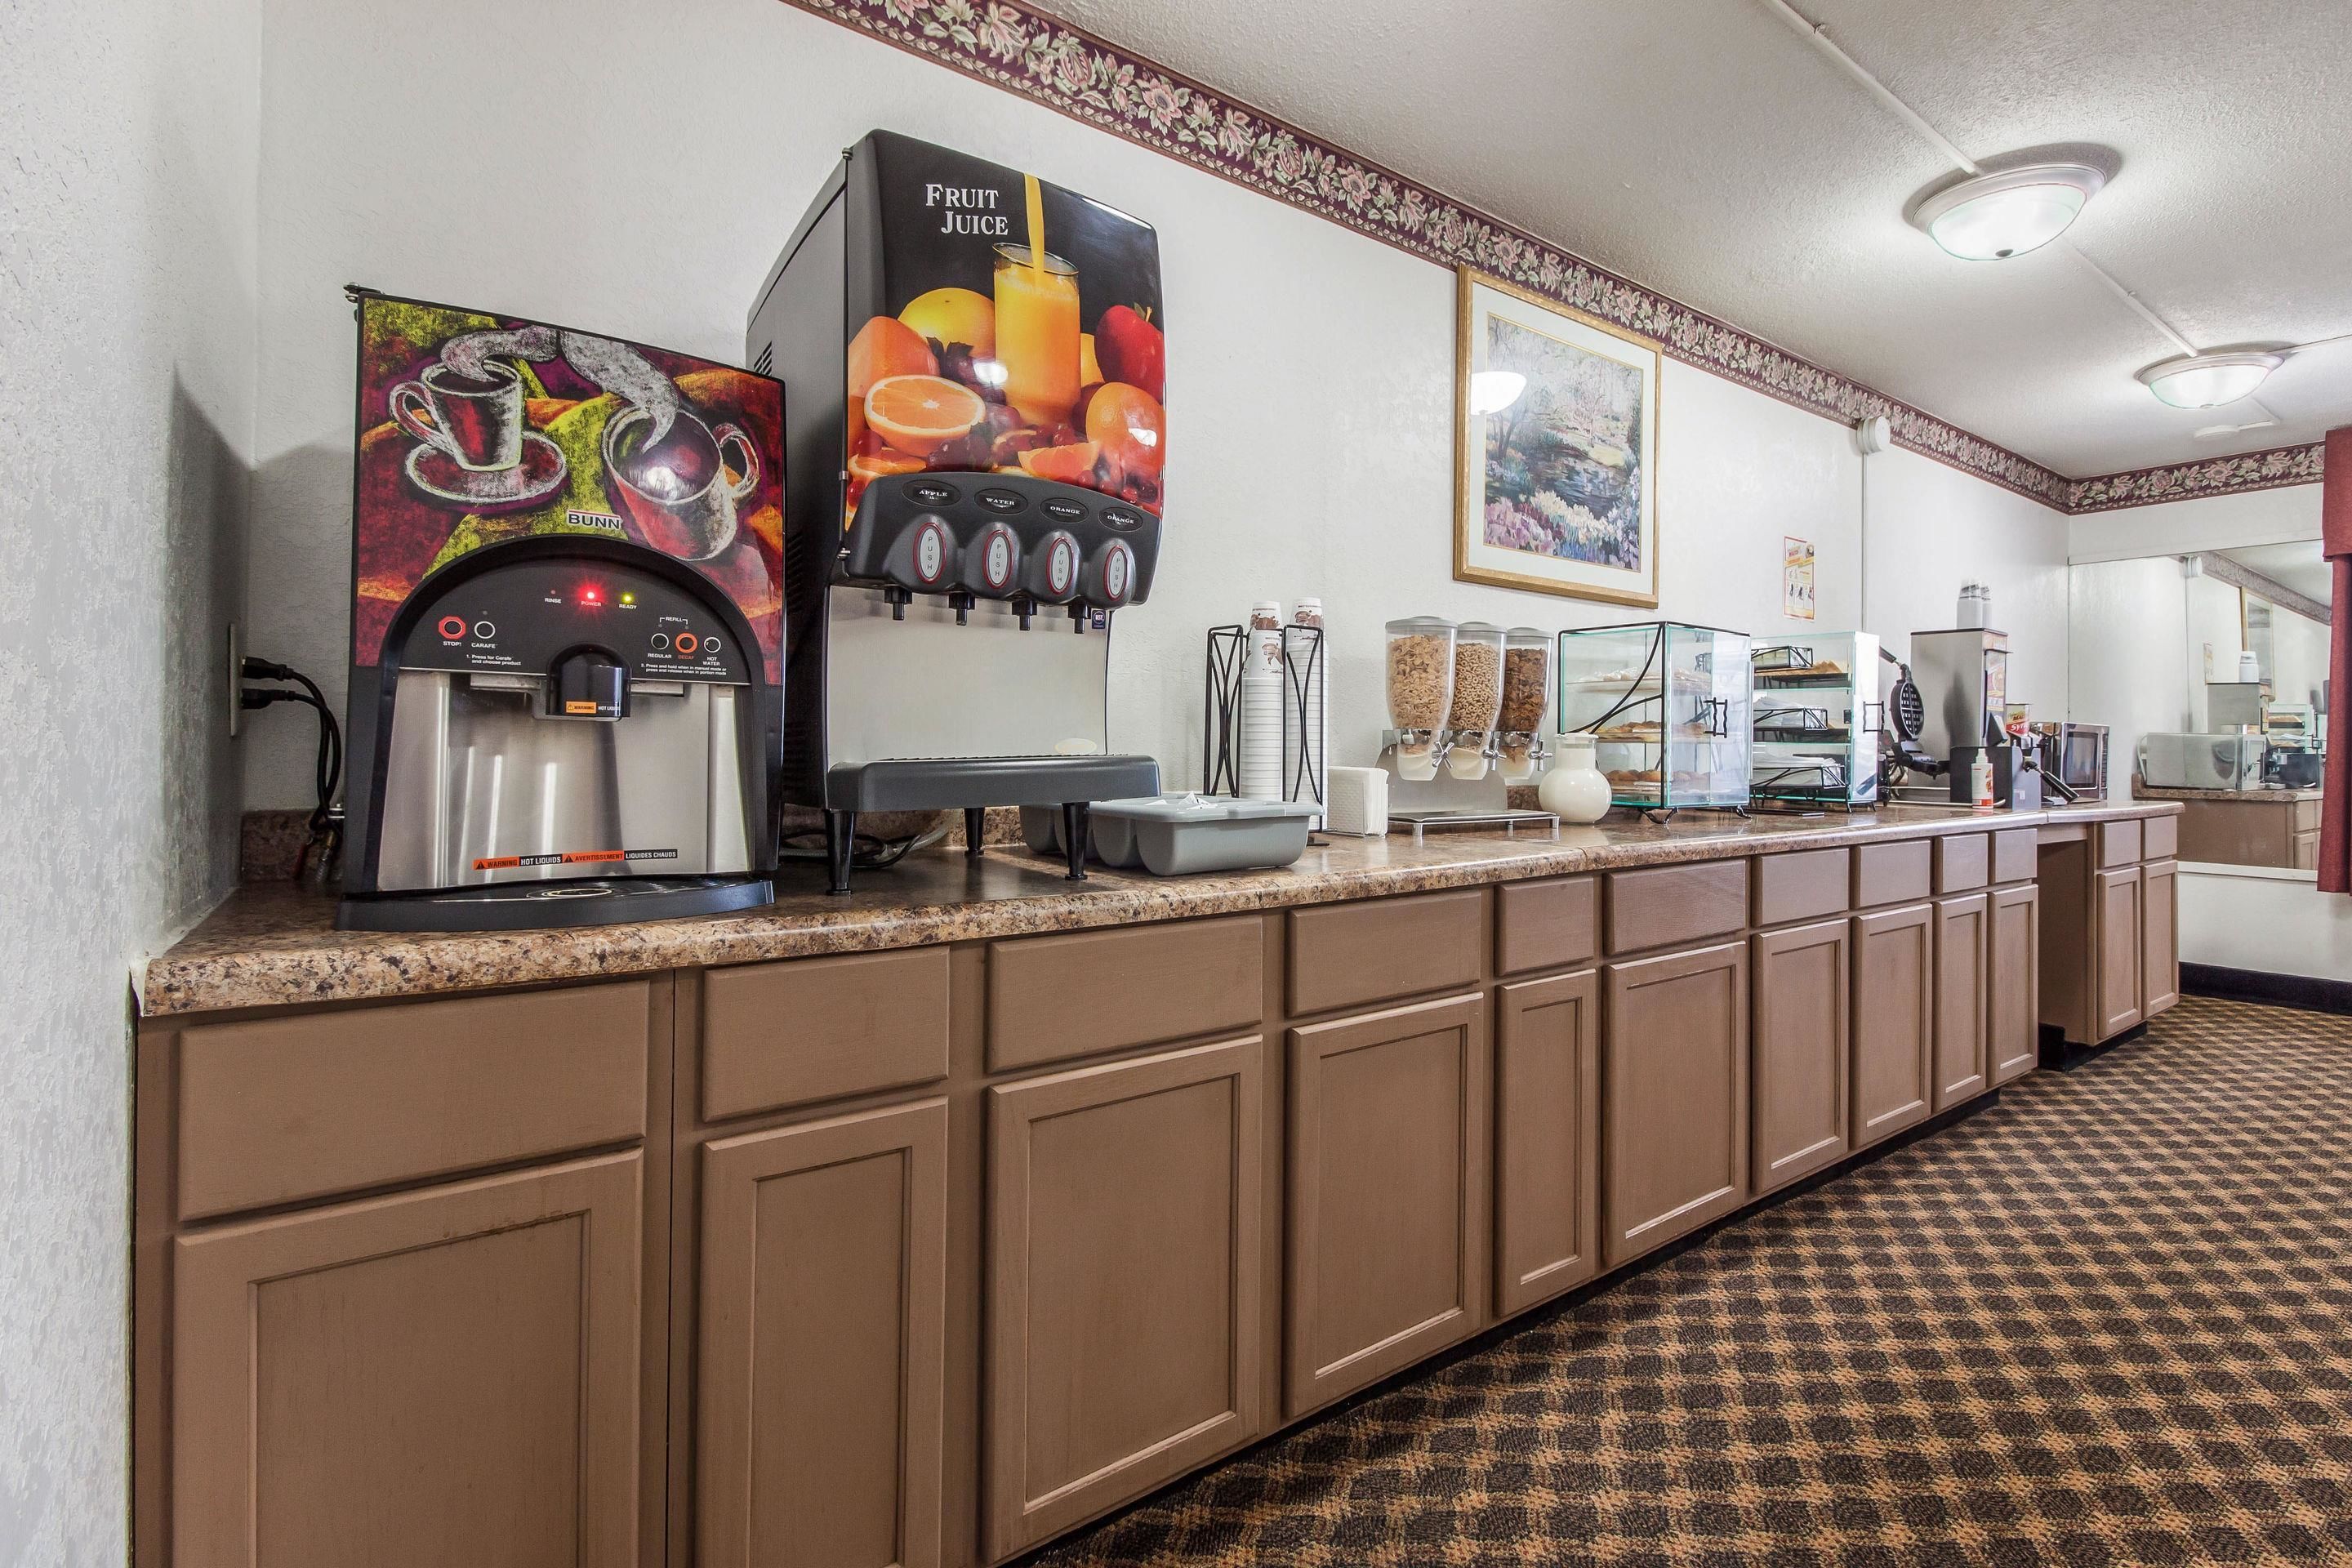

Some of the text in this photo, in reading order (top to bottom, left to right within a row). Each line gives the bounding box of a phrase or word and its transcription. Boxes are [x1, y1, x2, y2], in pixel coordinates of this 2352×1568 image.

[925, 184, 999, 209] FRUIT
[941, 211, 1009, 236] JUICE
[919, 489, 948, 497] APPLE
[986, 497, 1015, 506] WATER
[1050, 506, 1080, 514] ORANGE
[568, 514, 620, 529] BUNN
[1107, 514, 1134, 523] ORANGE
[488, 859, 518, 867] WARNING
[535, 856, 561, 865] LIQUIDS
[575, 853, 622, 862] AVERTISSEMENT
[626, 852, 653, 860] LIQUIDES
